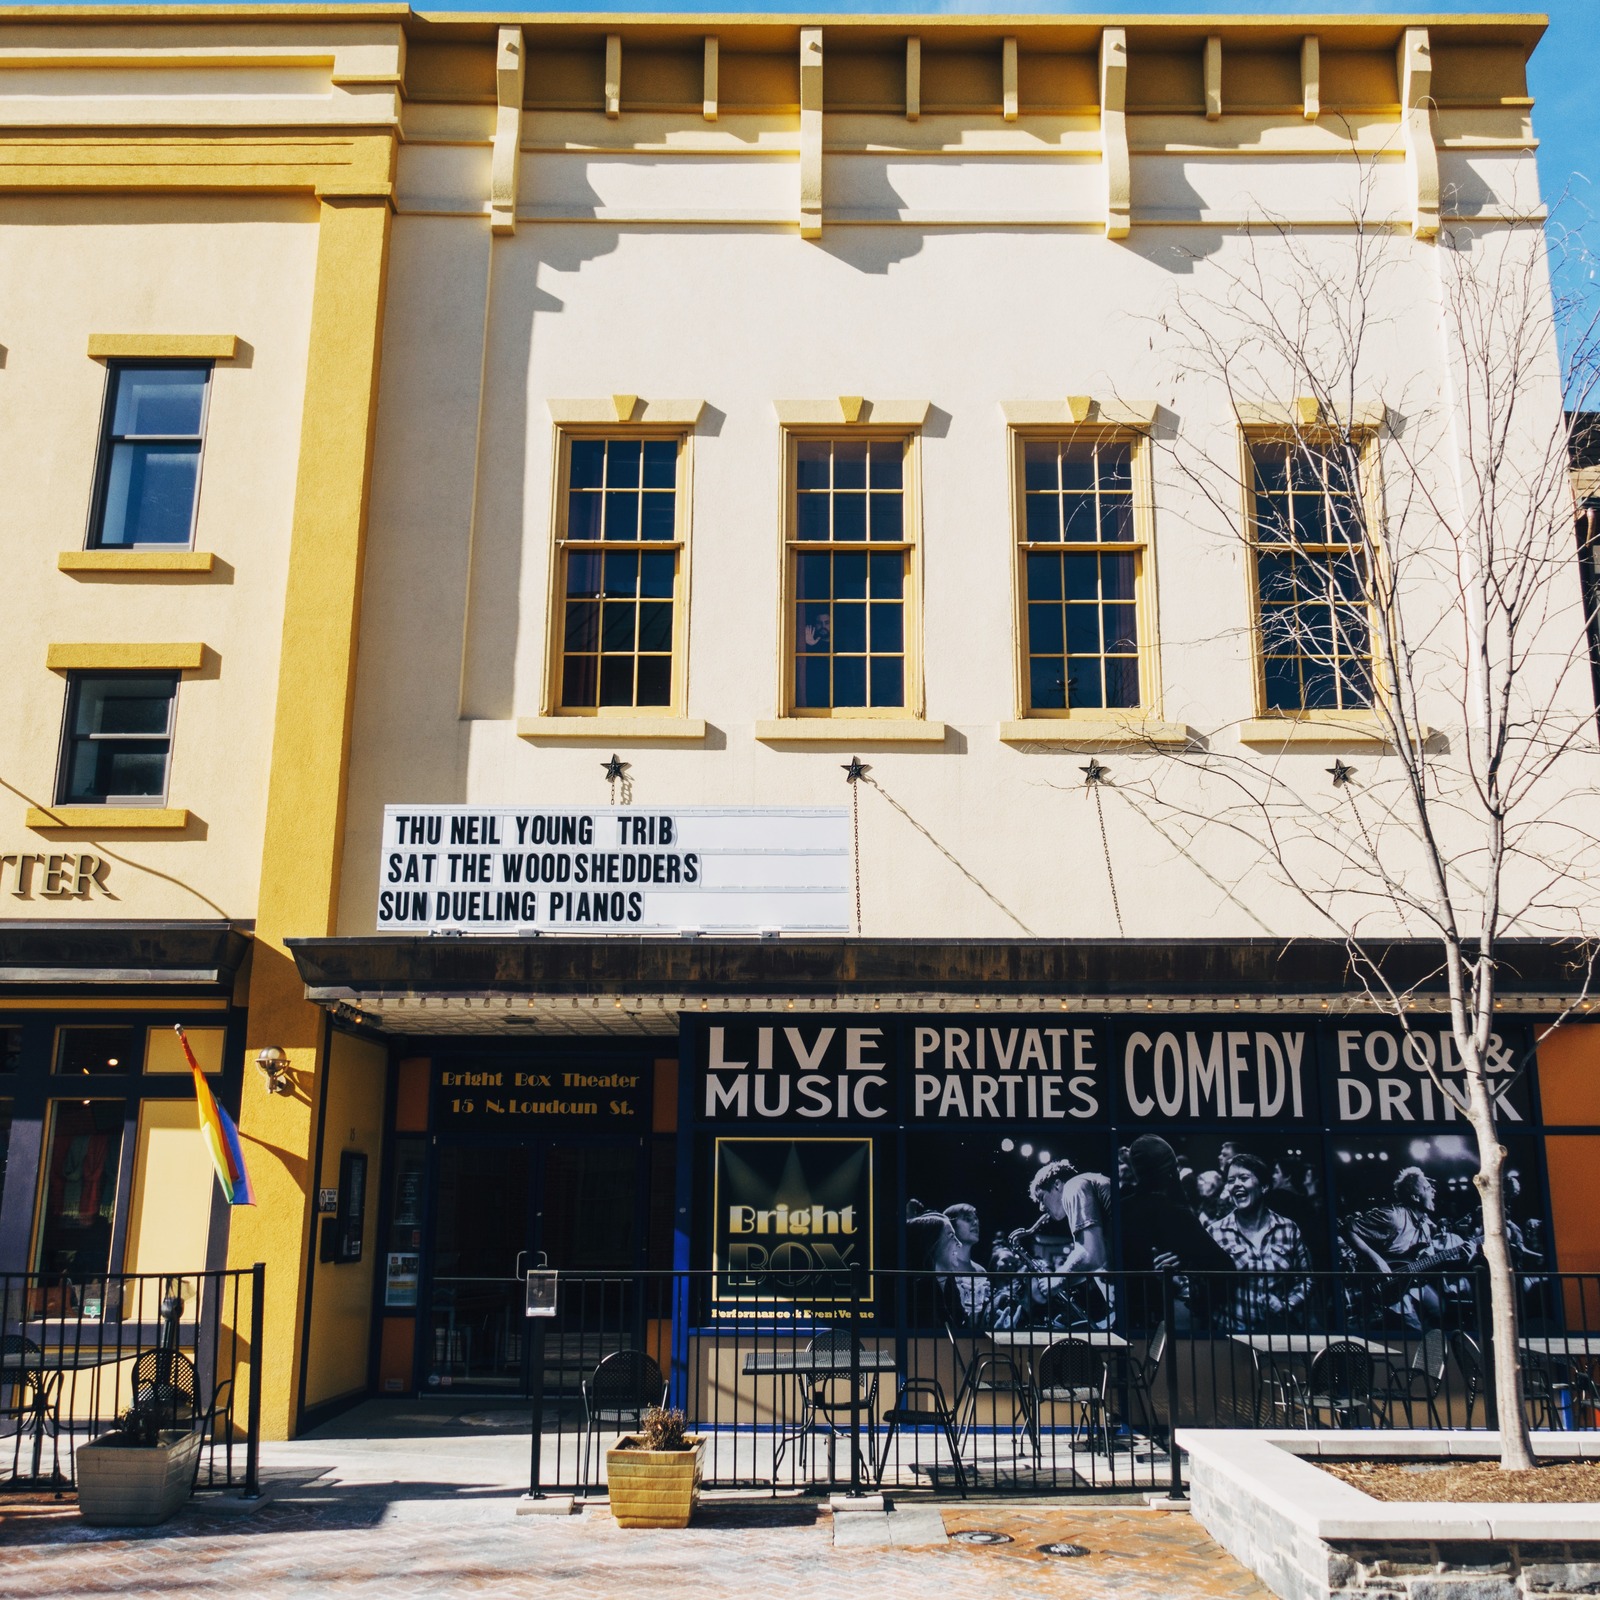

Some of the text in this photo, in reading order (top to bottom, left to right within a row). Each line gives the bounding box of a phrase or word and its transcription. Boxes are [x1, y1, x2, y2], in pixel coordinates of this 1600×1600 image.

[396, 815, 672, 845] THU NEIL YOUNG TRIB
[0, 853, 112, 895] TER
[388, 853, 697, 882] SAT THE WOODSHEDDERS
[380, 891, 641, 921] SUN DUELING PIANOS
[709, 1027, 885, 1070] LIVE
[915, 1028, 1096, 1070] PRIVATE
[1337, 1030, 1470, 1072] FOOD
[442, 1071, 640, 1088] Bright Box Theater
[706, 1074, 887, 1117] MUSIC
[1125, 1032, 1304, 1117] COMEDY
[451, 1099, 635, 1115] 15 N. Loudoun St.
[916, 1075, 1098, 1118] PARTIES
[1337, 1078, 1524, 1121] DRINK
[729, 1203, 859, 1236] Bright
[728, 1242, 855, 1287] BOX
[711, 1308, 791, 1319] Performance
[803, 1309, 838, 1319] Event
[838, 1309, 875, 1319] Veue
